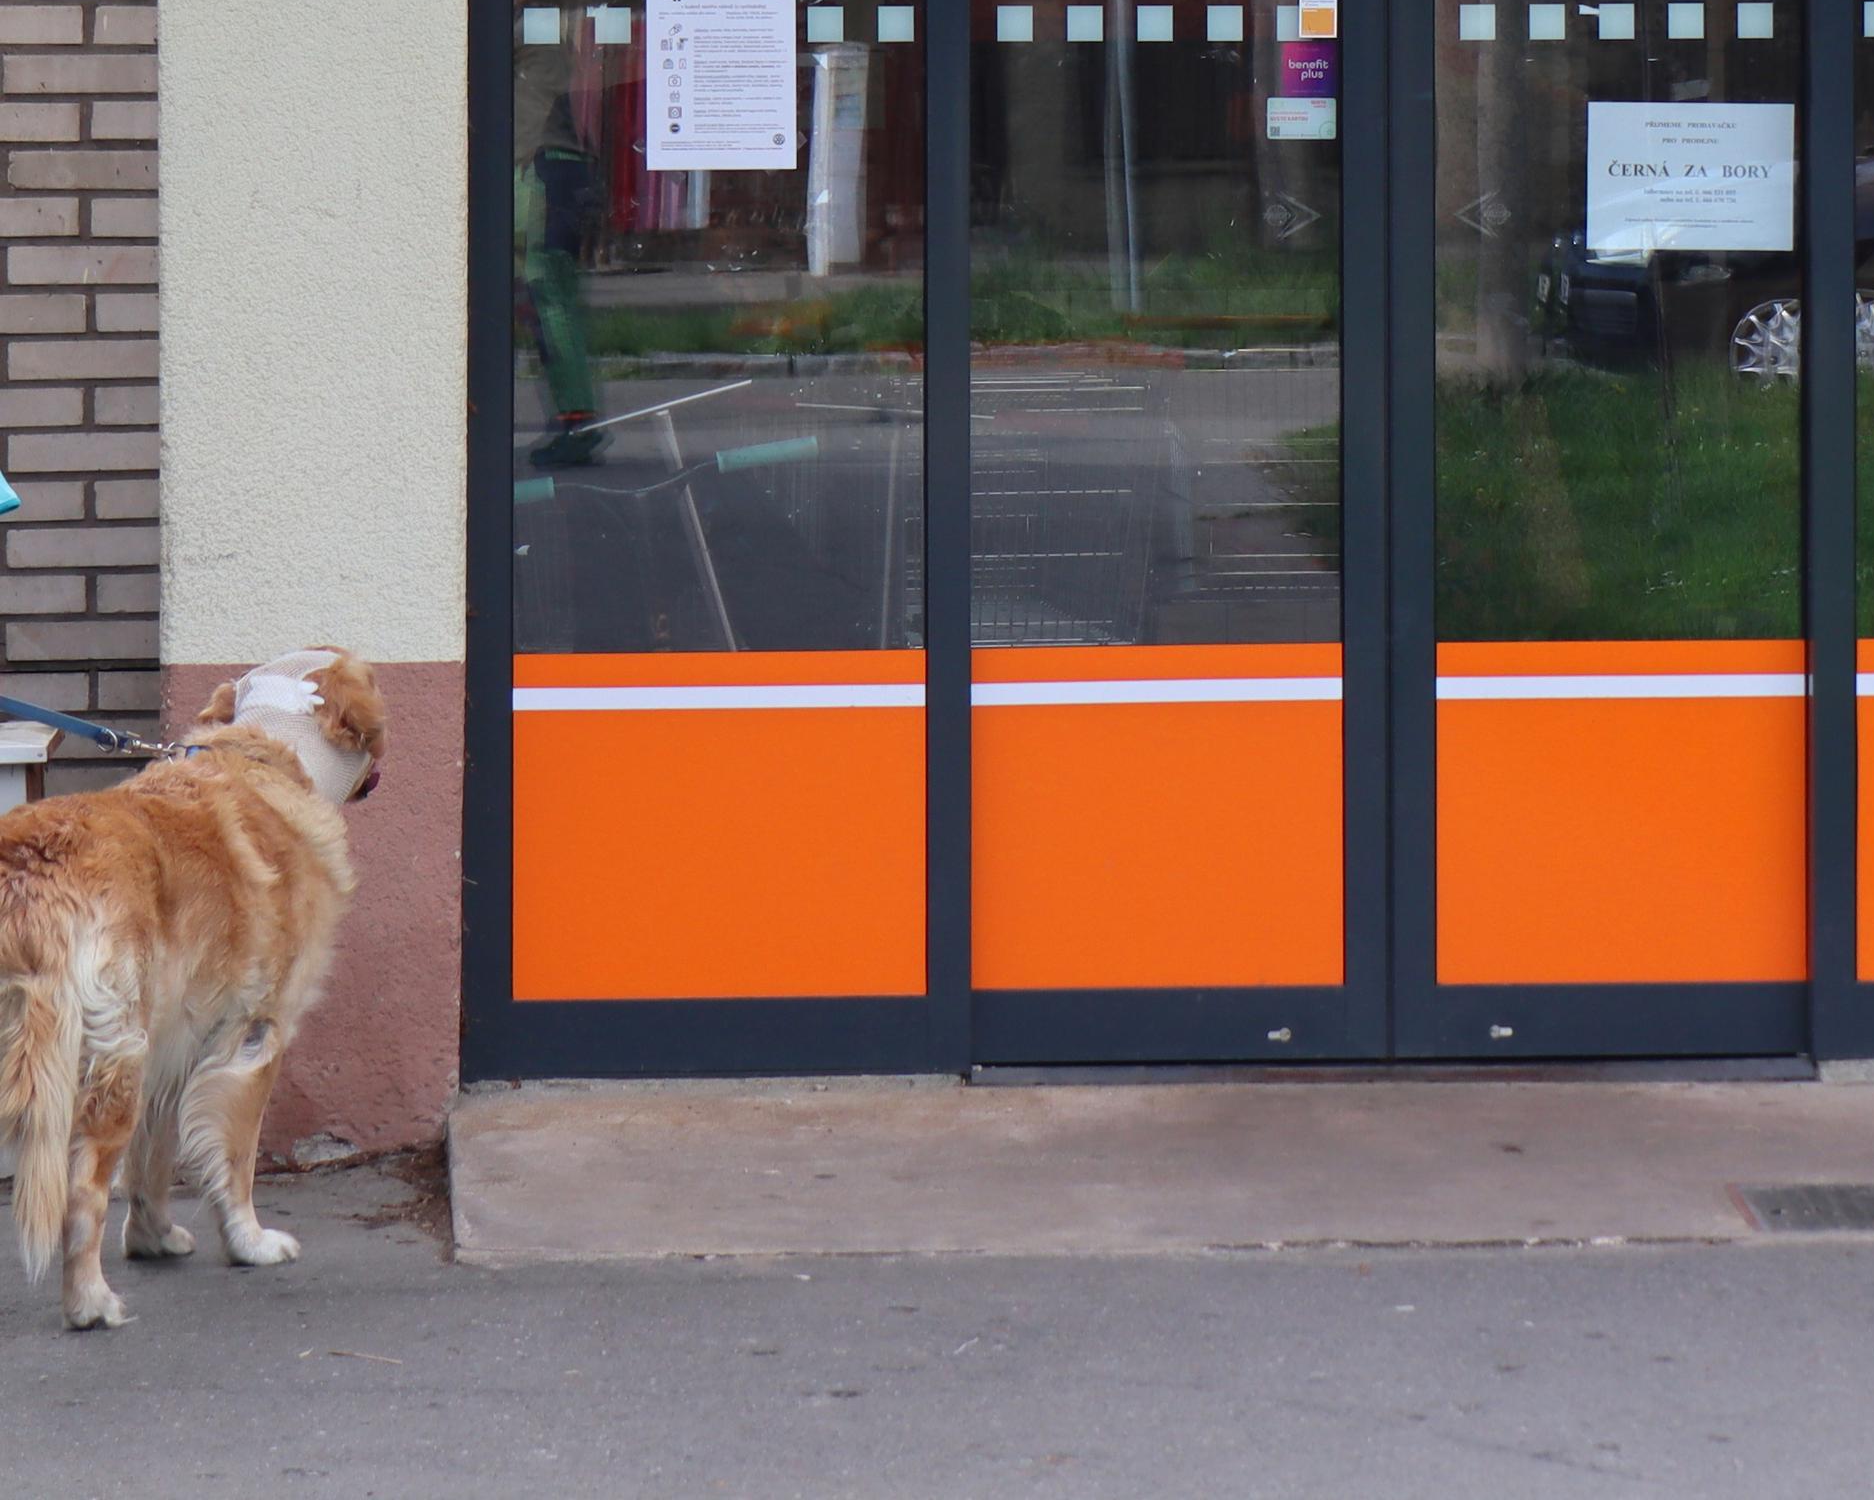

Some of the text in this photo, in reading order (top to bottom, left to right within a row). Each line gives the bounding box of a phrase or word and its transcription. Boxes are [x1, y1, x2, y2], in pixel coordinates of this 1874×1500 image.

[1287, 59, 1329, 70] benefit
[1300, 70, 1324, 81] plus
[1608, 160, 1772, 178] ČERNÁ ZA BORY
